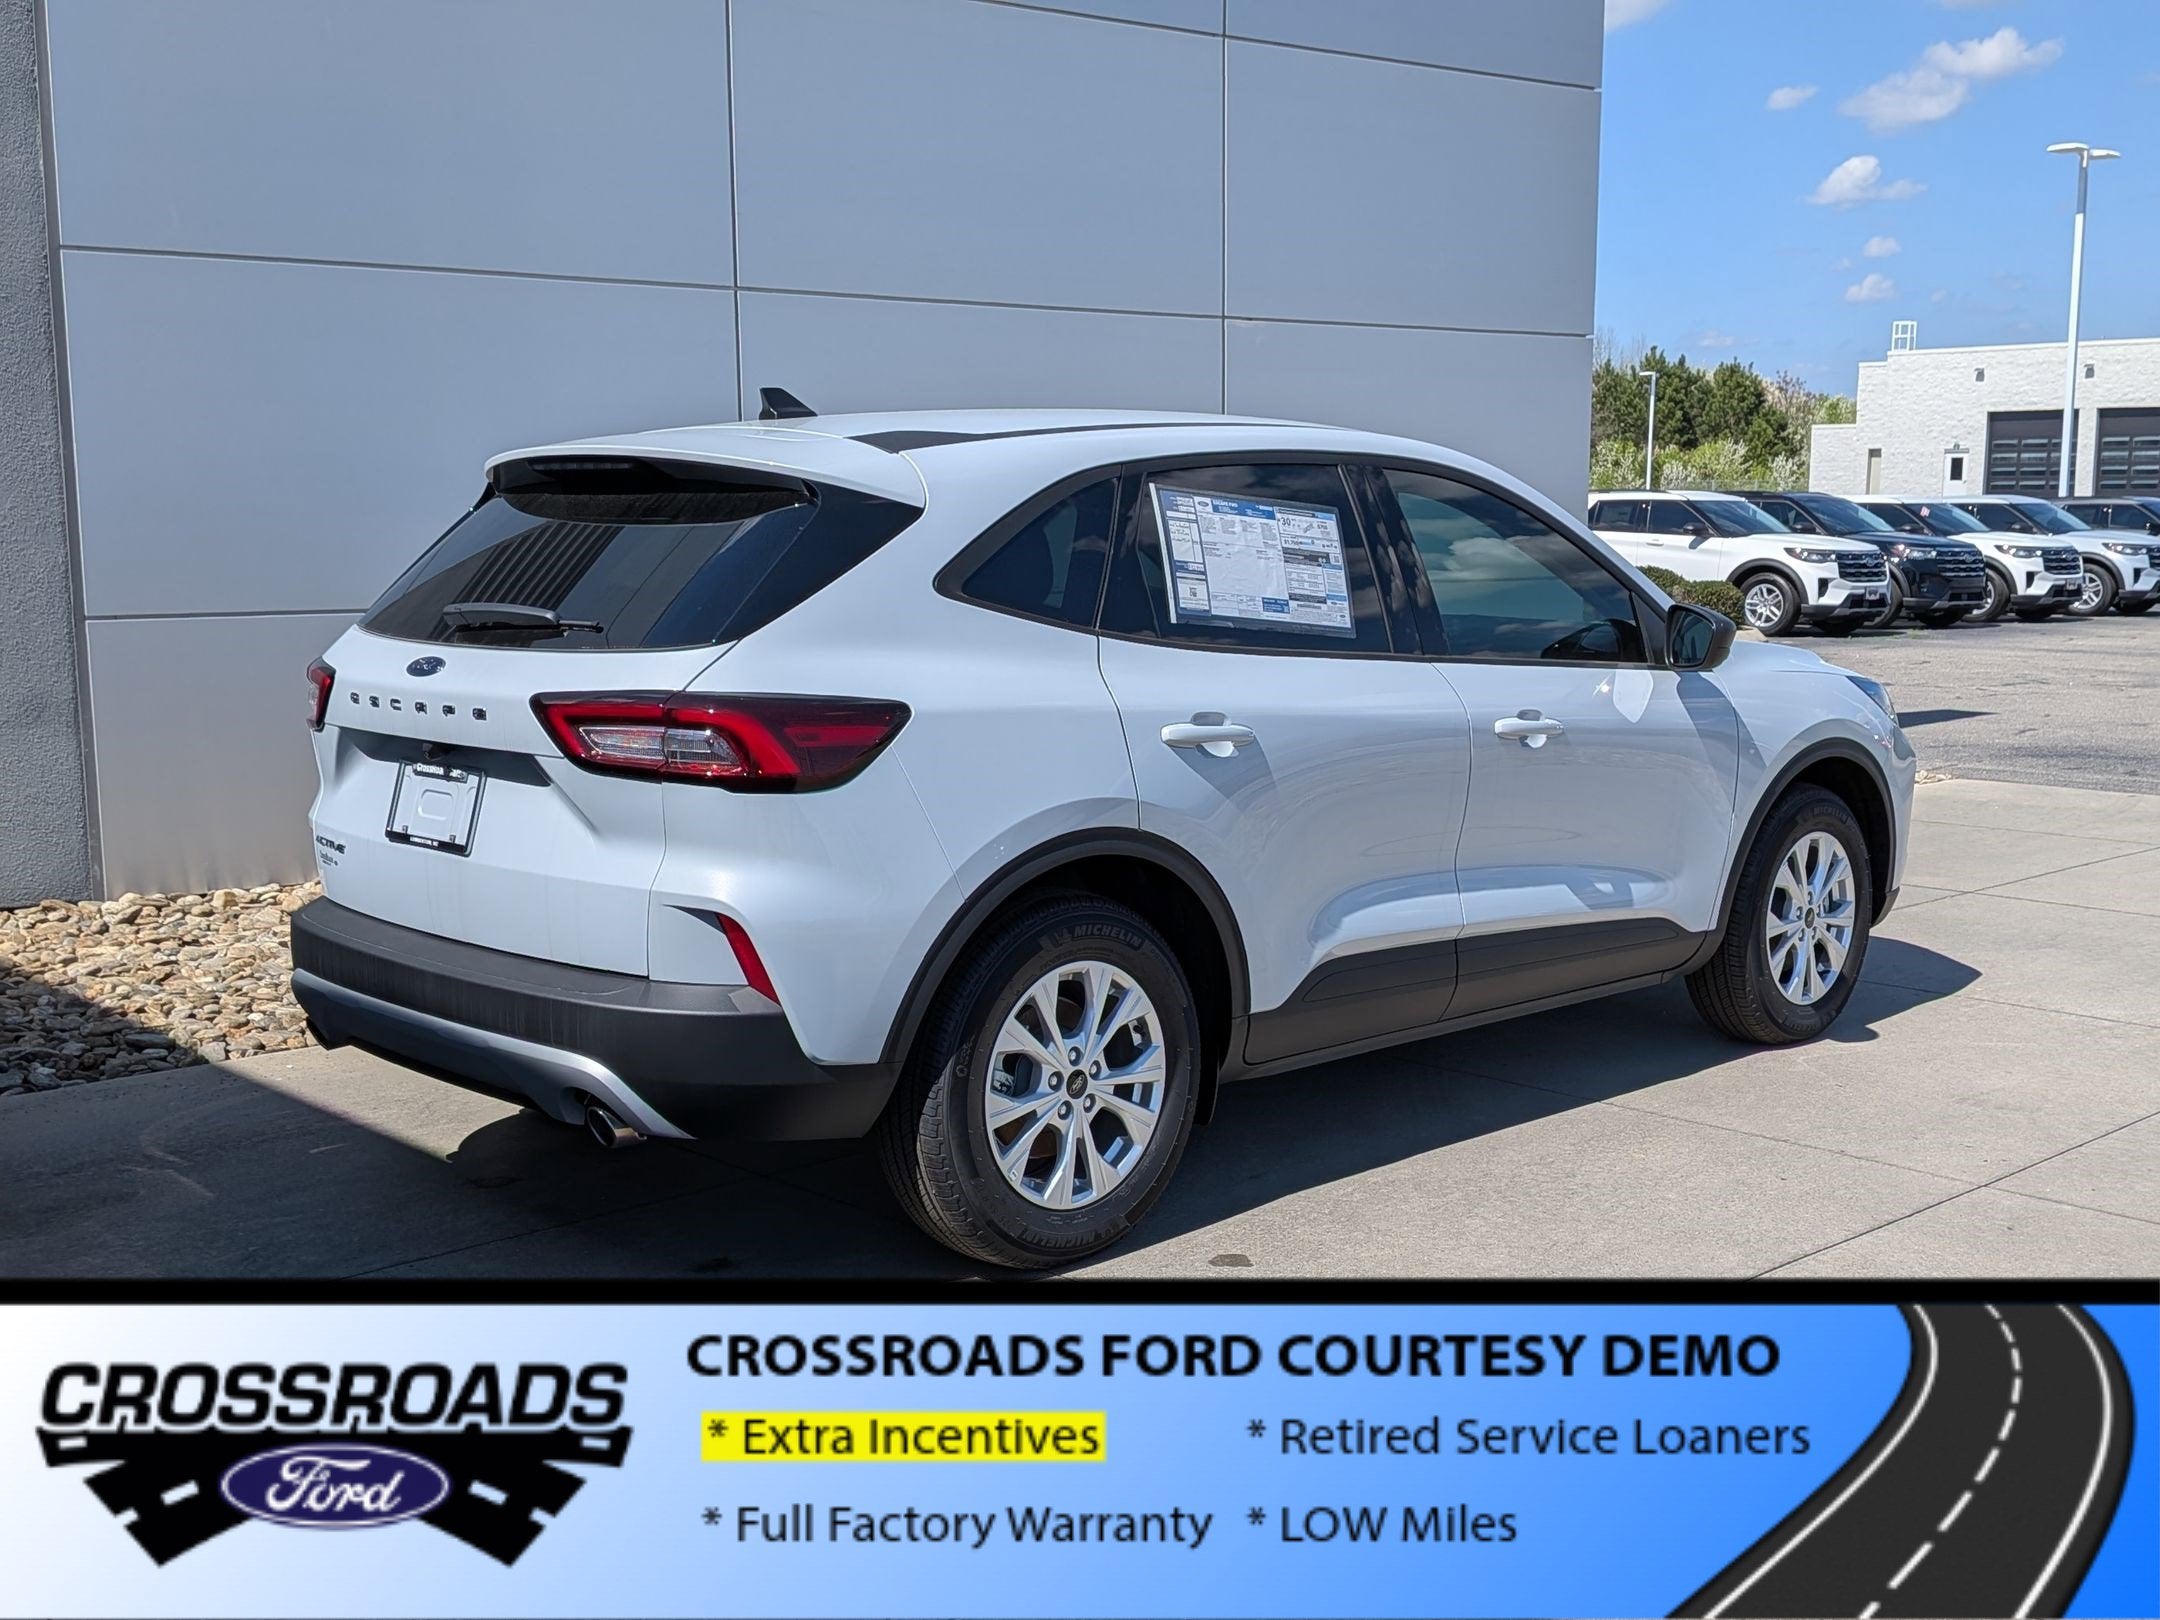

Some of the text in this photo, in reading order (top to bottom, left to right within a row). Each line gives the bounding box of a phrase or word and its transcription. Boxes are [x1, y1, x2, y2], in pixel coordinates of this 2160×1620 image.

[350, 692, 487, 721] ESCAPE
[316, 835, 346, 855] ACTIVE
[1073, 924, 1144, 949] MICHELIN
